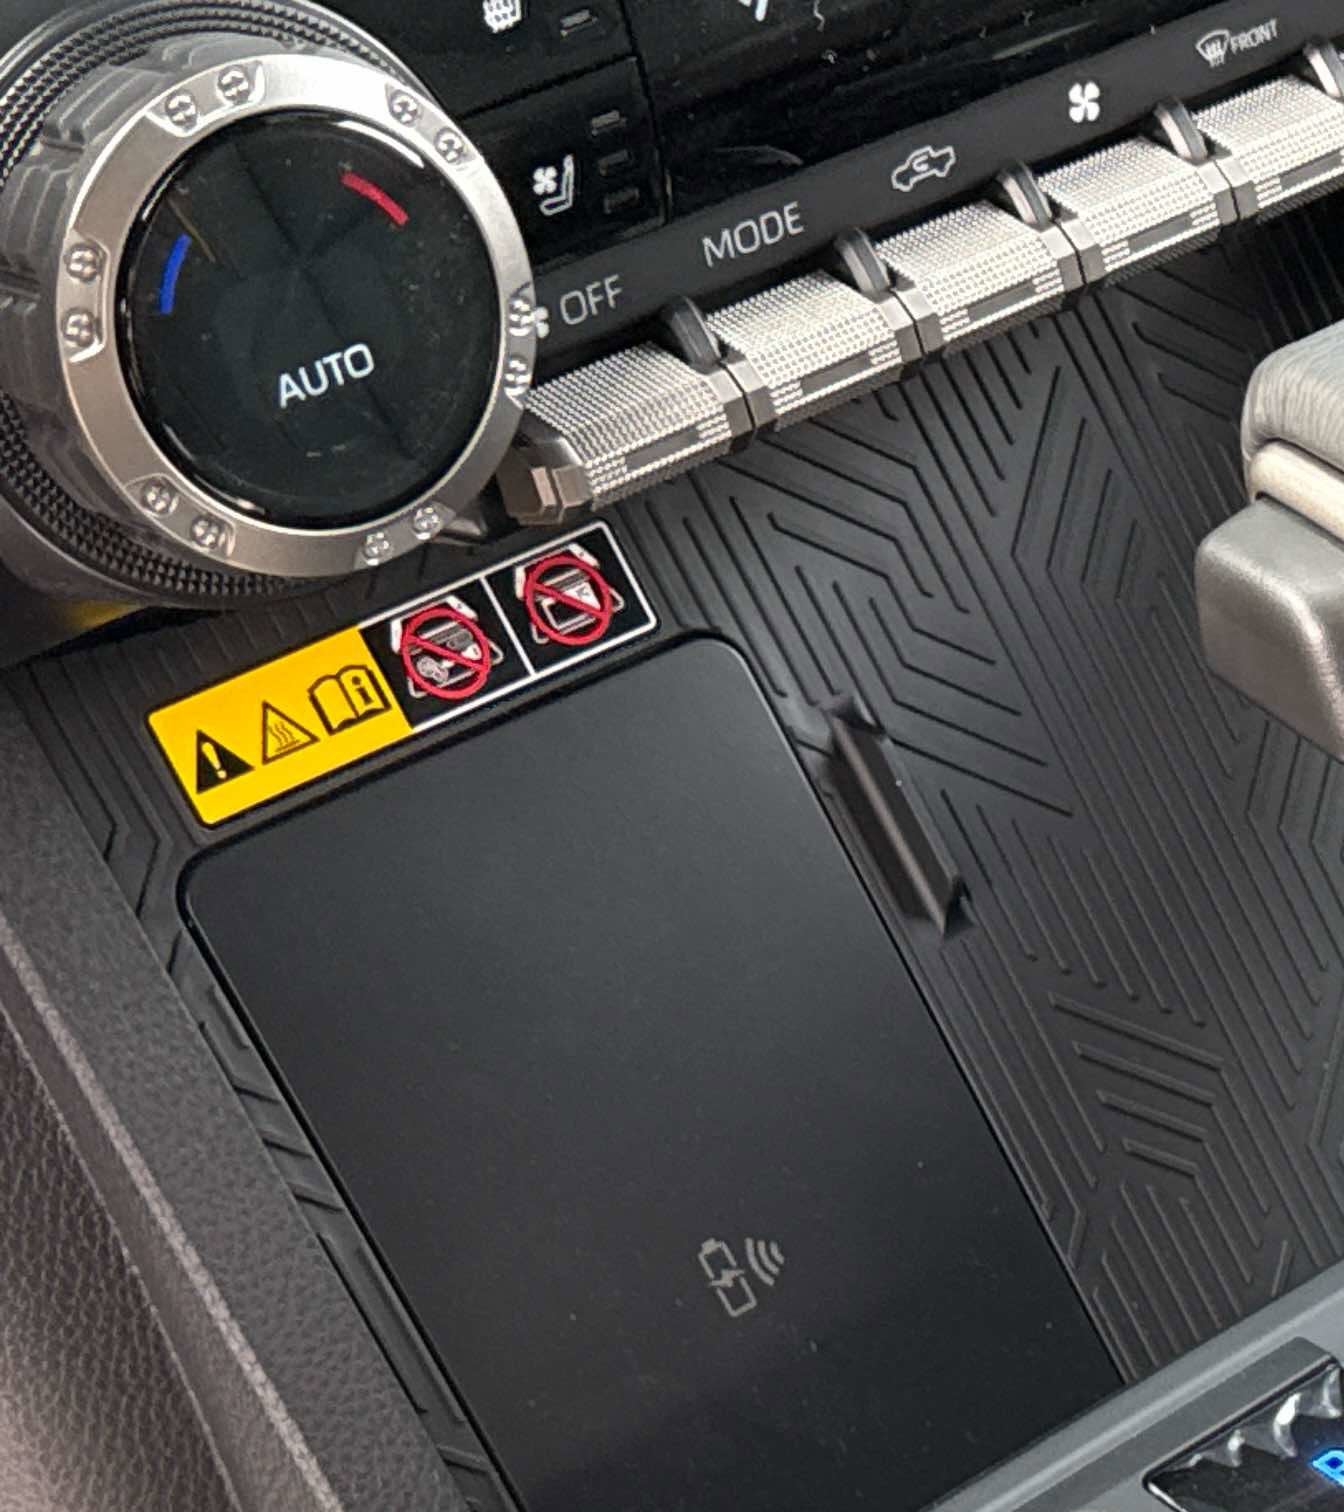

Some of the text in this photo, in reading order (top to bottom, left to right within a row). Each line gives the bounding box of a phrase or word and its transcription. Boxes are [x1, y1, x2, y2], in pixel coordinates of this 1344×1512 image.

[1230, 18, 1279, 54] FRONT
[701, 200, 805, 268] MODE
[559, 273, 624, 327] OFF
[276, 342, 376, 408] AUTO
